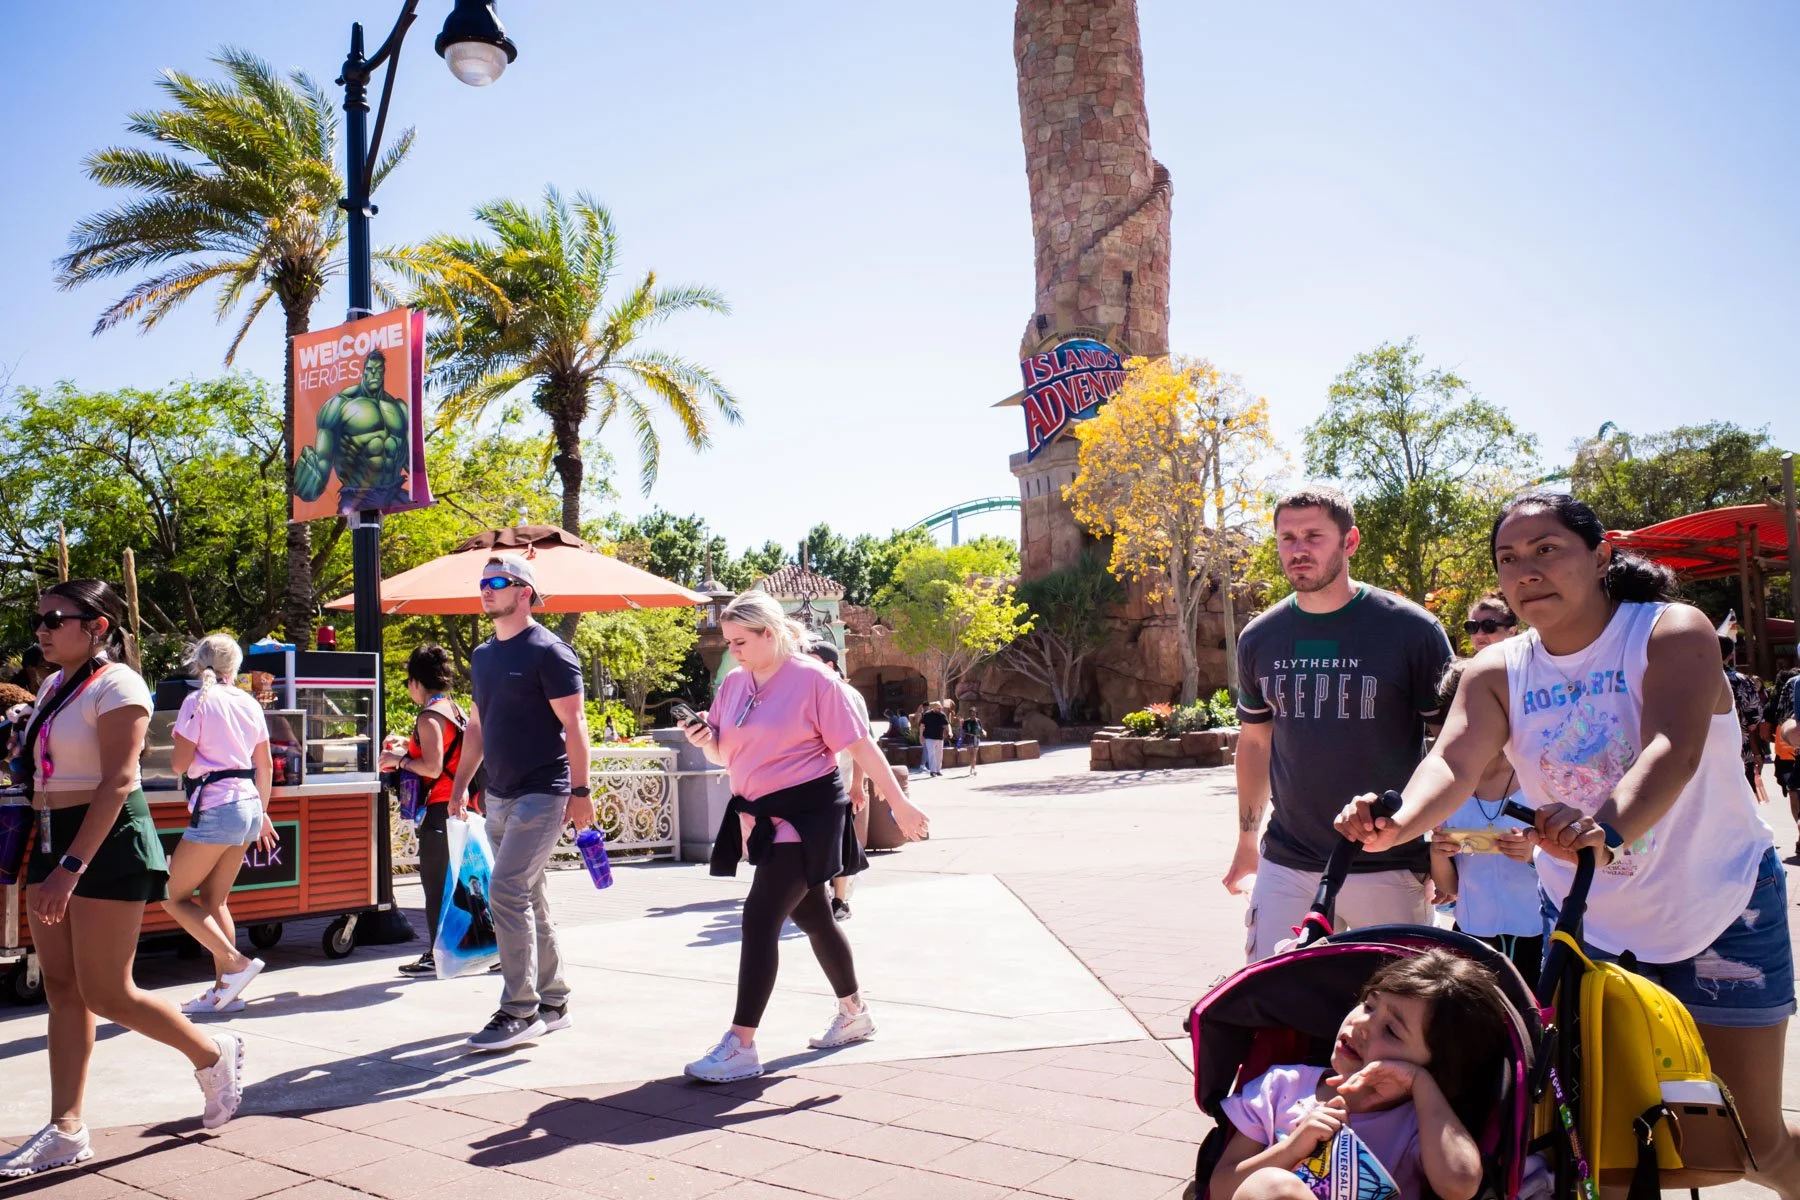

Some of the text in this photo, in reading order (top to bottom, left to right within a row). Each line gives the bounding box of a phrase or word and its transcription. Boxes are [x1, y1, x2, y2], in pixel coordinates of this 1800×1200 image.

[299, 322, 404, 369] WELCOME
[1022, 349, 1118, 389] ISLANDS
[1023, 370, 1127, 453] ADVENT
[1274, 658, 1359, 669] SLYTHERIN
[1523, 670, 1628, 715] HOGRTS
[241, 846, 282, 868] ALK
[1340, 1134, 1349, 1190] UNIVERSAL
